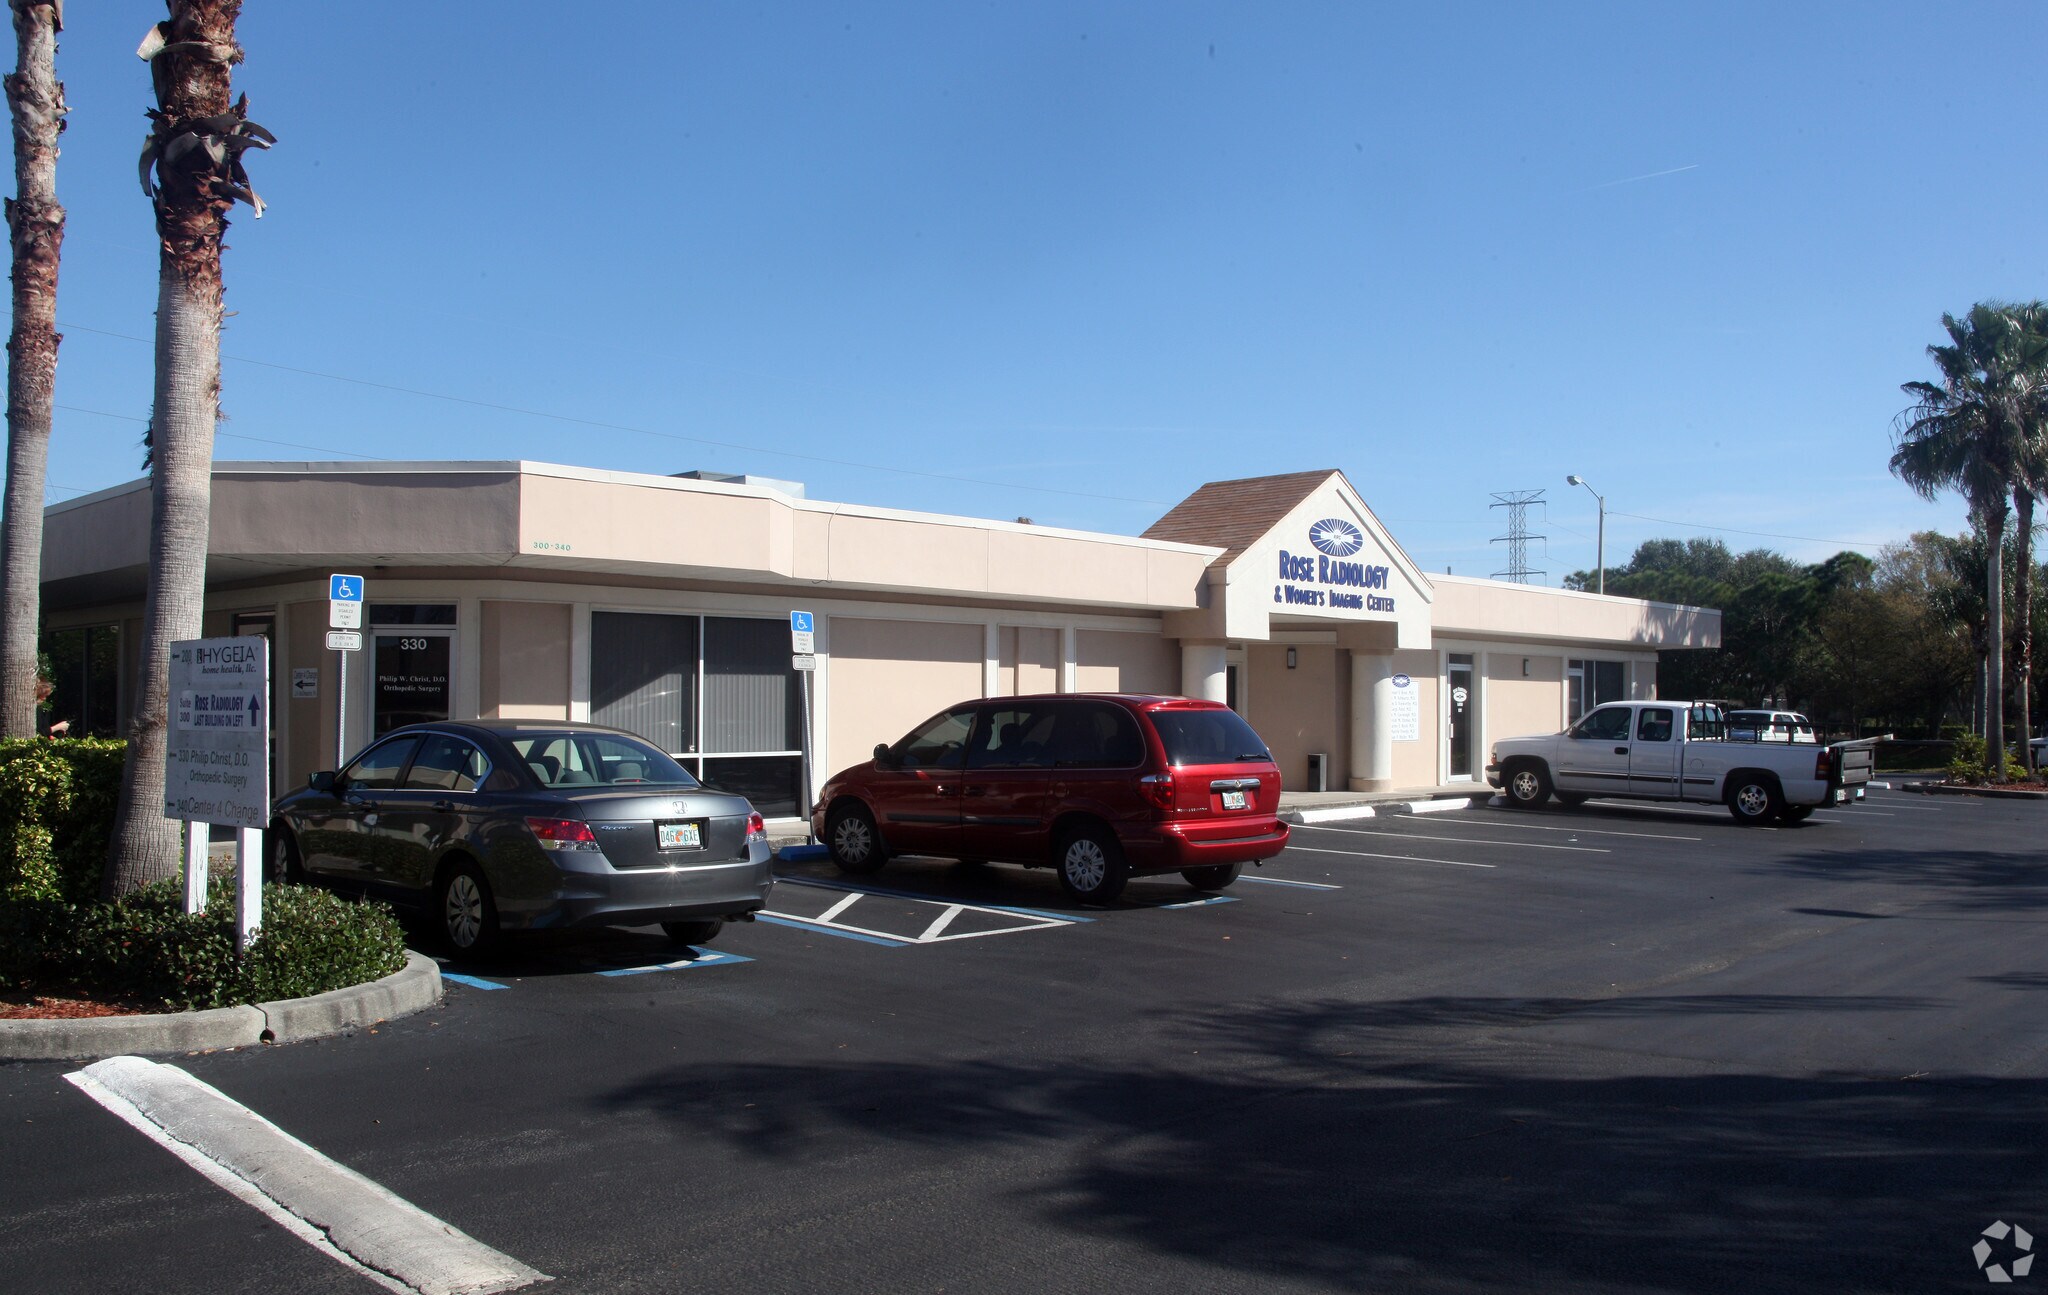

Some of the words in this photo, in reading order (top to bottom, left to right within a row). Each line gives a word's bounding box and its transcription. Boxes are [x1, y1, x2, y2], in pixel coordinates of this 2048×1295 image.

[1279, 549, 1314, 582] ROSE
[1318, 554, 1389, 590] RADIOLOGY
[1274, 585, 1282, 603] &
[1284, 584, 1325, 607] WOMEN'S
[1329, 589, 1363, 610] IMAGING
[1366, 593, 1395, 613] CENTER
[400, 638, 428, 650] 330
[203, 646, 256, 664] HYGEIA
[202, 665, 219, 675] home
[220, 664, 244, 676] health,
[379, 675, 398, 683] Philip
[383, 684, 416, 692] Orthopedic
[179, 698, 191, 708] Suite
[194, 694, 209, 711] ROSE
[211, 694, 244, 711] RADIOLOGY
[179, 711, 191, 722] 300
[194, 714, 204, 726] LAST
[205, 714, 225, 727] BUILDING
[225, 715, 232, 727] ON
[233, 715, 244, 727] LEFT
[178, 750, 190, 763] 330
[210, 751, 233, 768] Christ,
[234, 752, 250, 767] D.O.
[189, 769, 222, 785] Orthopedic
[223, 772, 248, 788] Surgery
[188, 796, 215, 815] Center
[217, 800, 222, 816] 4
[225, 800, 259, 824] Change
